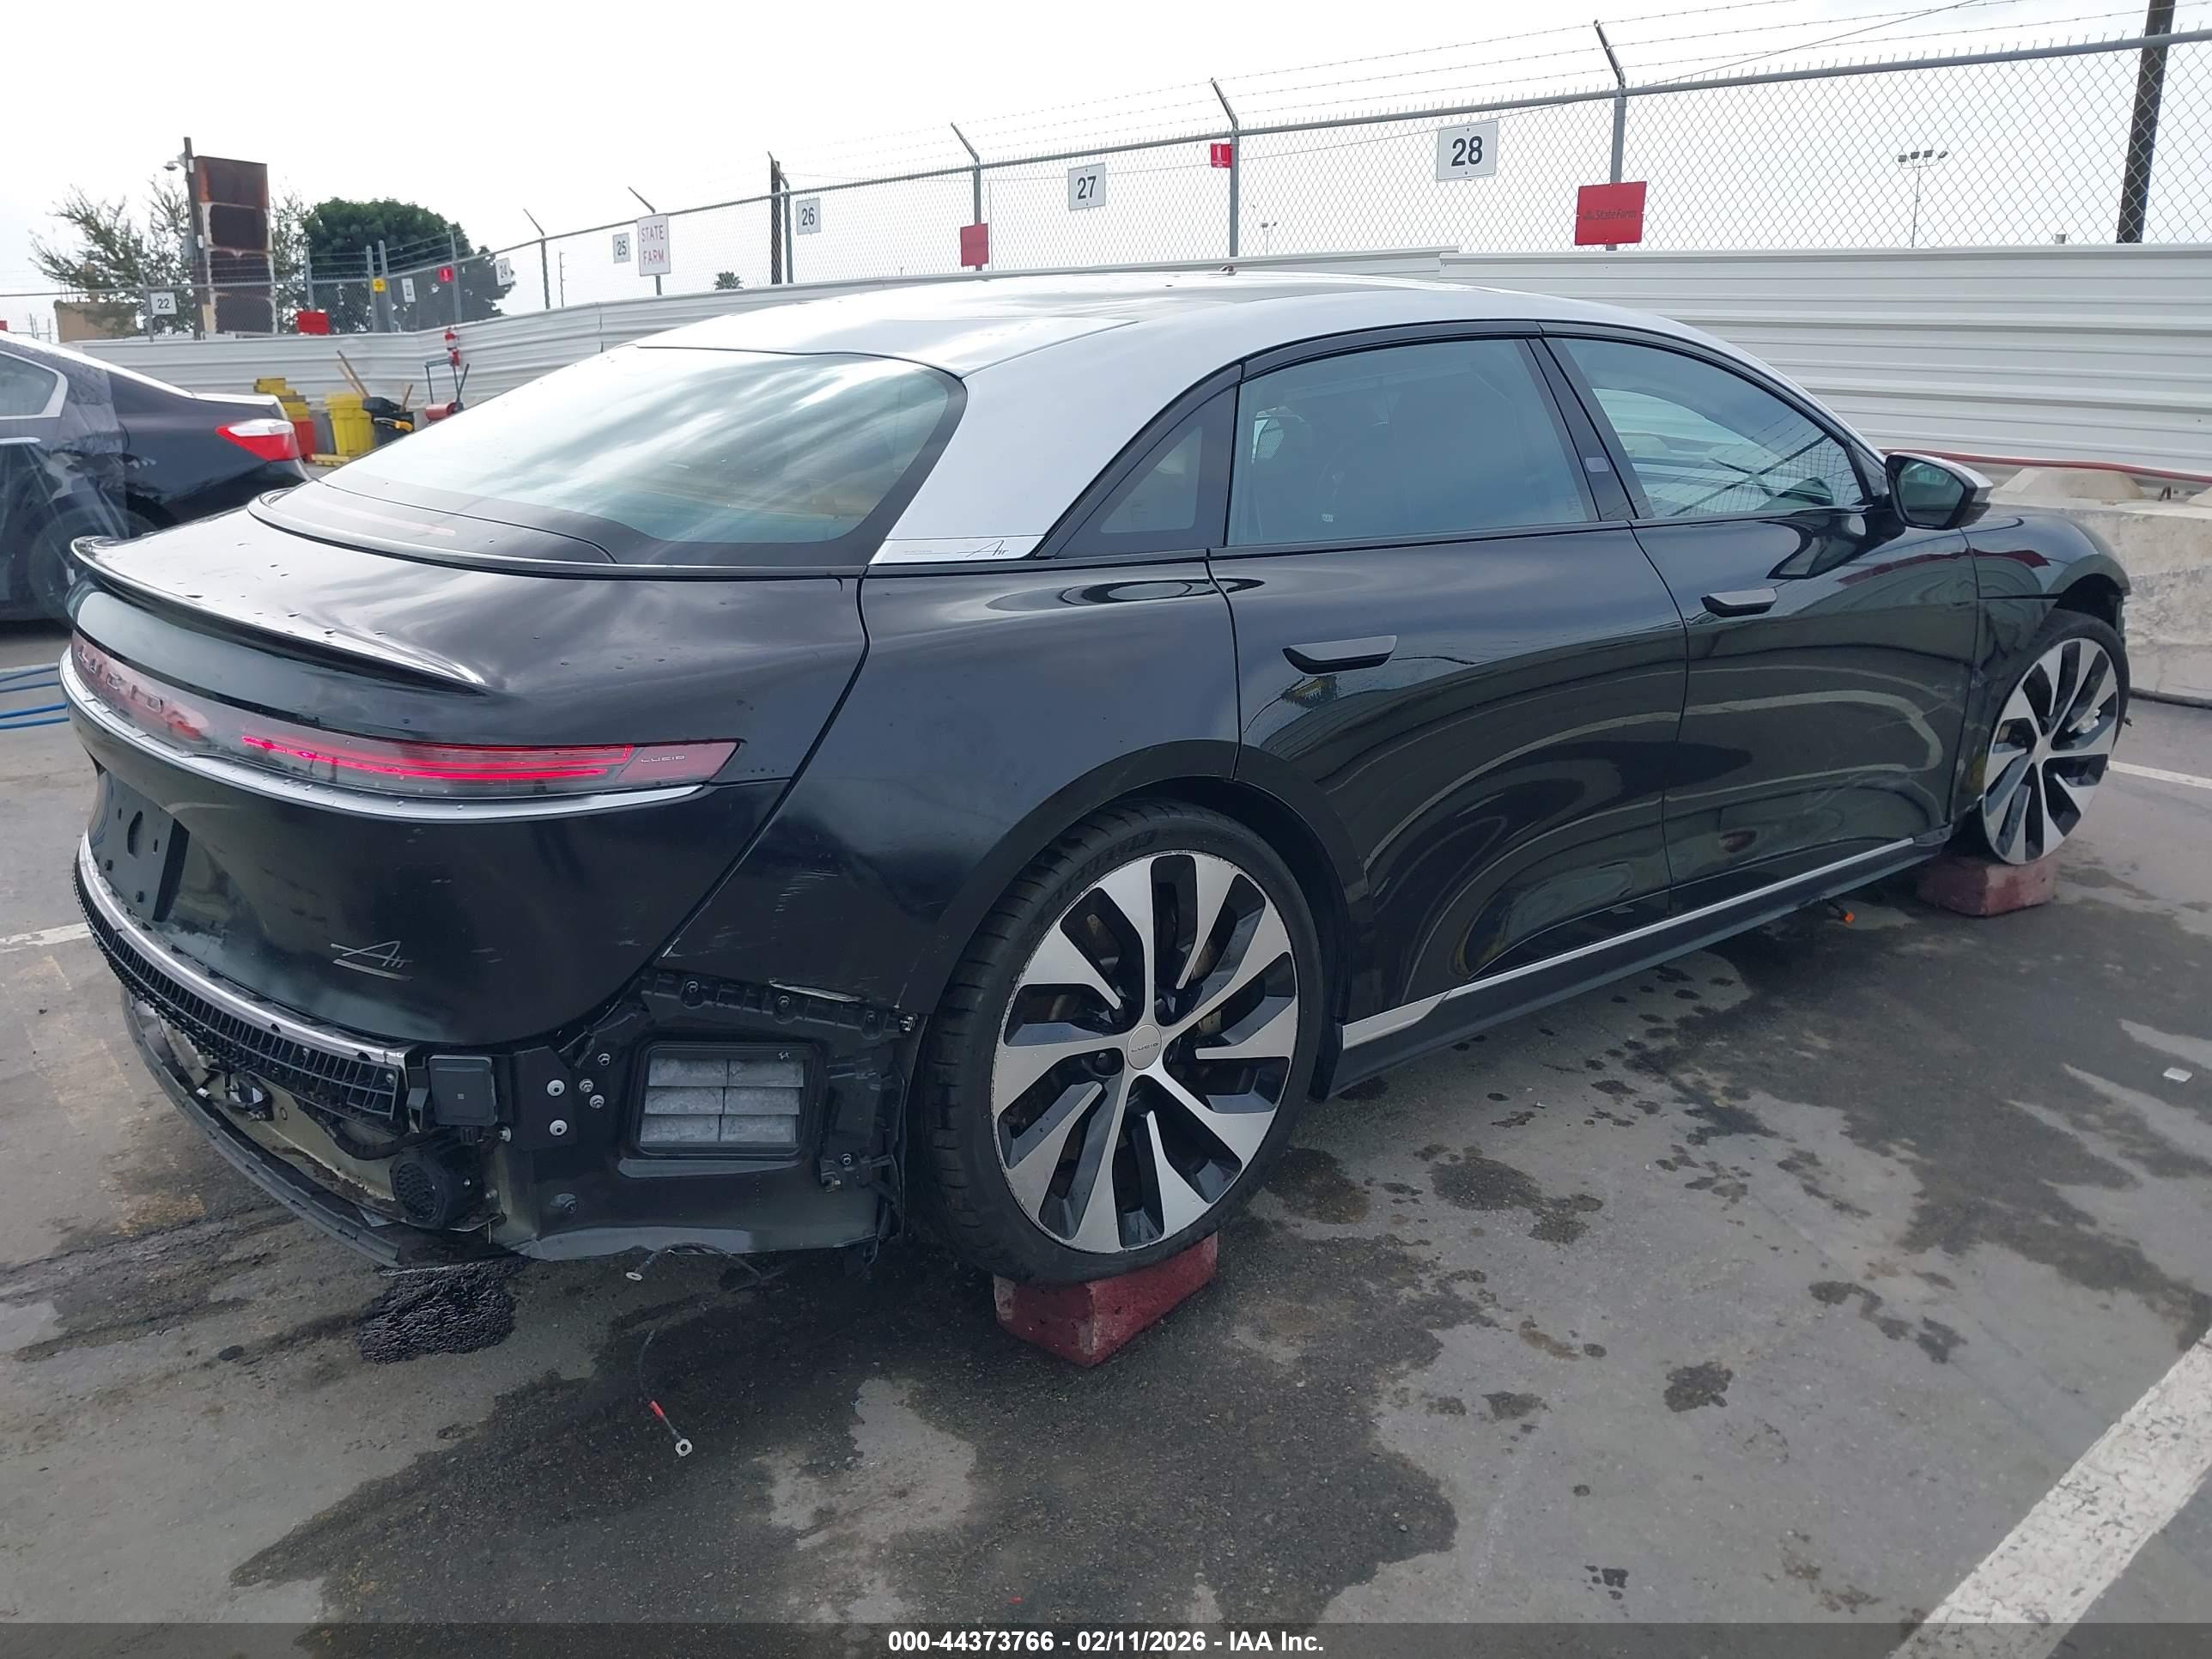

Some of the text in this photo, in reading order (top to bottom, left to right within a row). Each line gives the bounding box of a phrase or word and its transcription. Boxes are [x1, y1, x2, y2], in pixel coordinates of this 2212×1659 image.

[1451, 136, 1483, 167] 28
[1077, 175, 1097, 200] 27
[802, 207, 815, 226] 26
[641, 225, 665, 242] STATE
[617, 240, 627, 256] 25
[643, 249, 665, 265] FARM
[157, 298, 171, 309] 22
